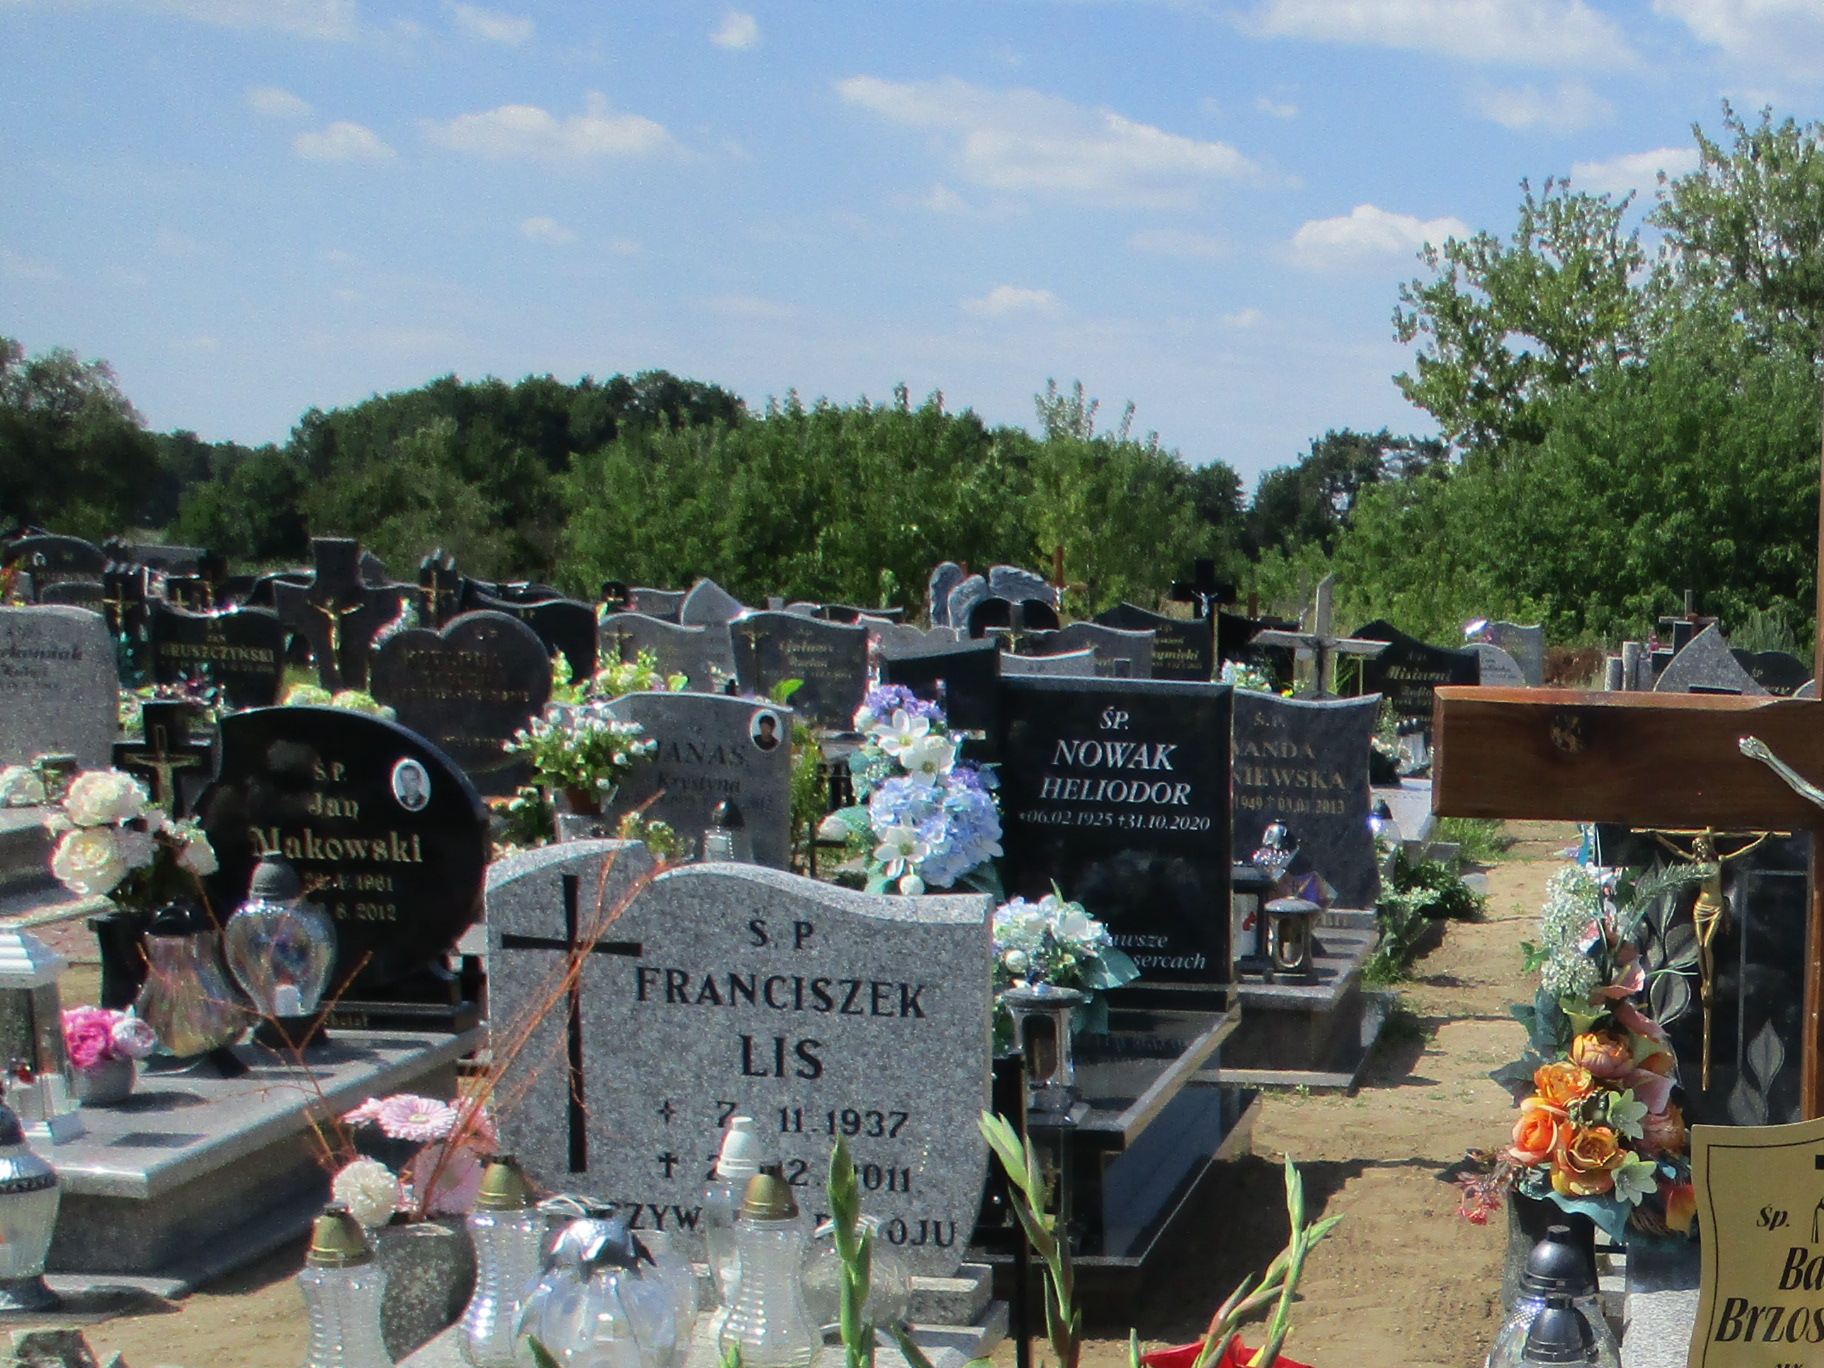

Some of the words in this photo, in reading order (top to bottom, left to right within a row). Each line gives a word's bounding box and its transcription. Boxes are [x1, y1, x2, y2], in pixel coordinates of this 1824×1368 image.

[1052, 738, 1179, 771] NOWAK
[1038, 776, 1192, 806] HELIODOR
[1231, 767, 1346, 790] NIEWSKA
[308, 792, 360, 821] Jan
[249, 825, 423, 863] Makowski
[1132, 952, 1207, 971] sercach
[635, 966, 927, 1019] FRANCISZEK
[738, 1035, 825, 1080] LIS
